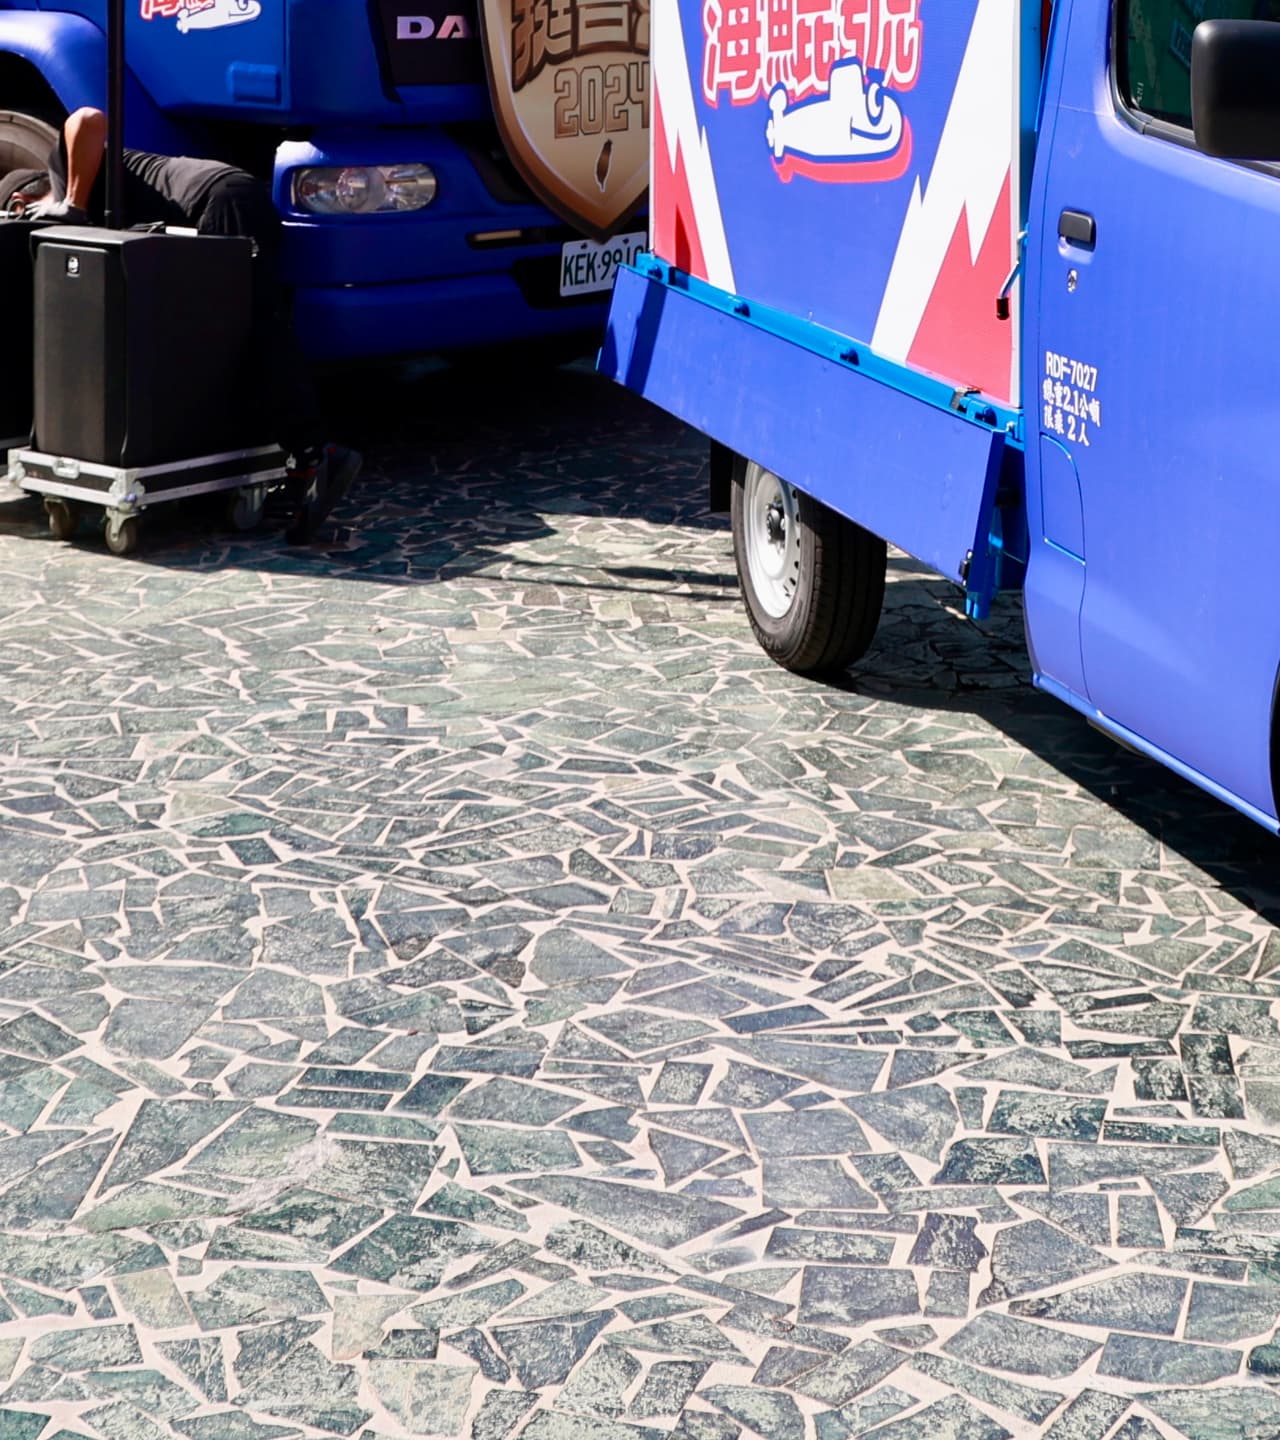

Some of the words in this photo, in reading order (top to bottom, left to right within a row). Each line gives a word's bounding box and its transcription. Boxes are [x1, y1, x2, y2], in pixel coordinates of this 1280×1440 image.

[396, 14, 471, 40] DA
[554, 61, 650, 139] 2024
[1045, 350, 1098, 392] RDF-7027
